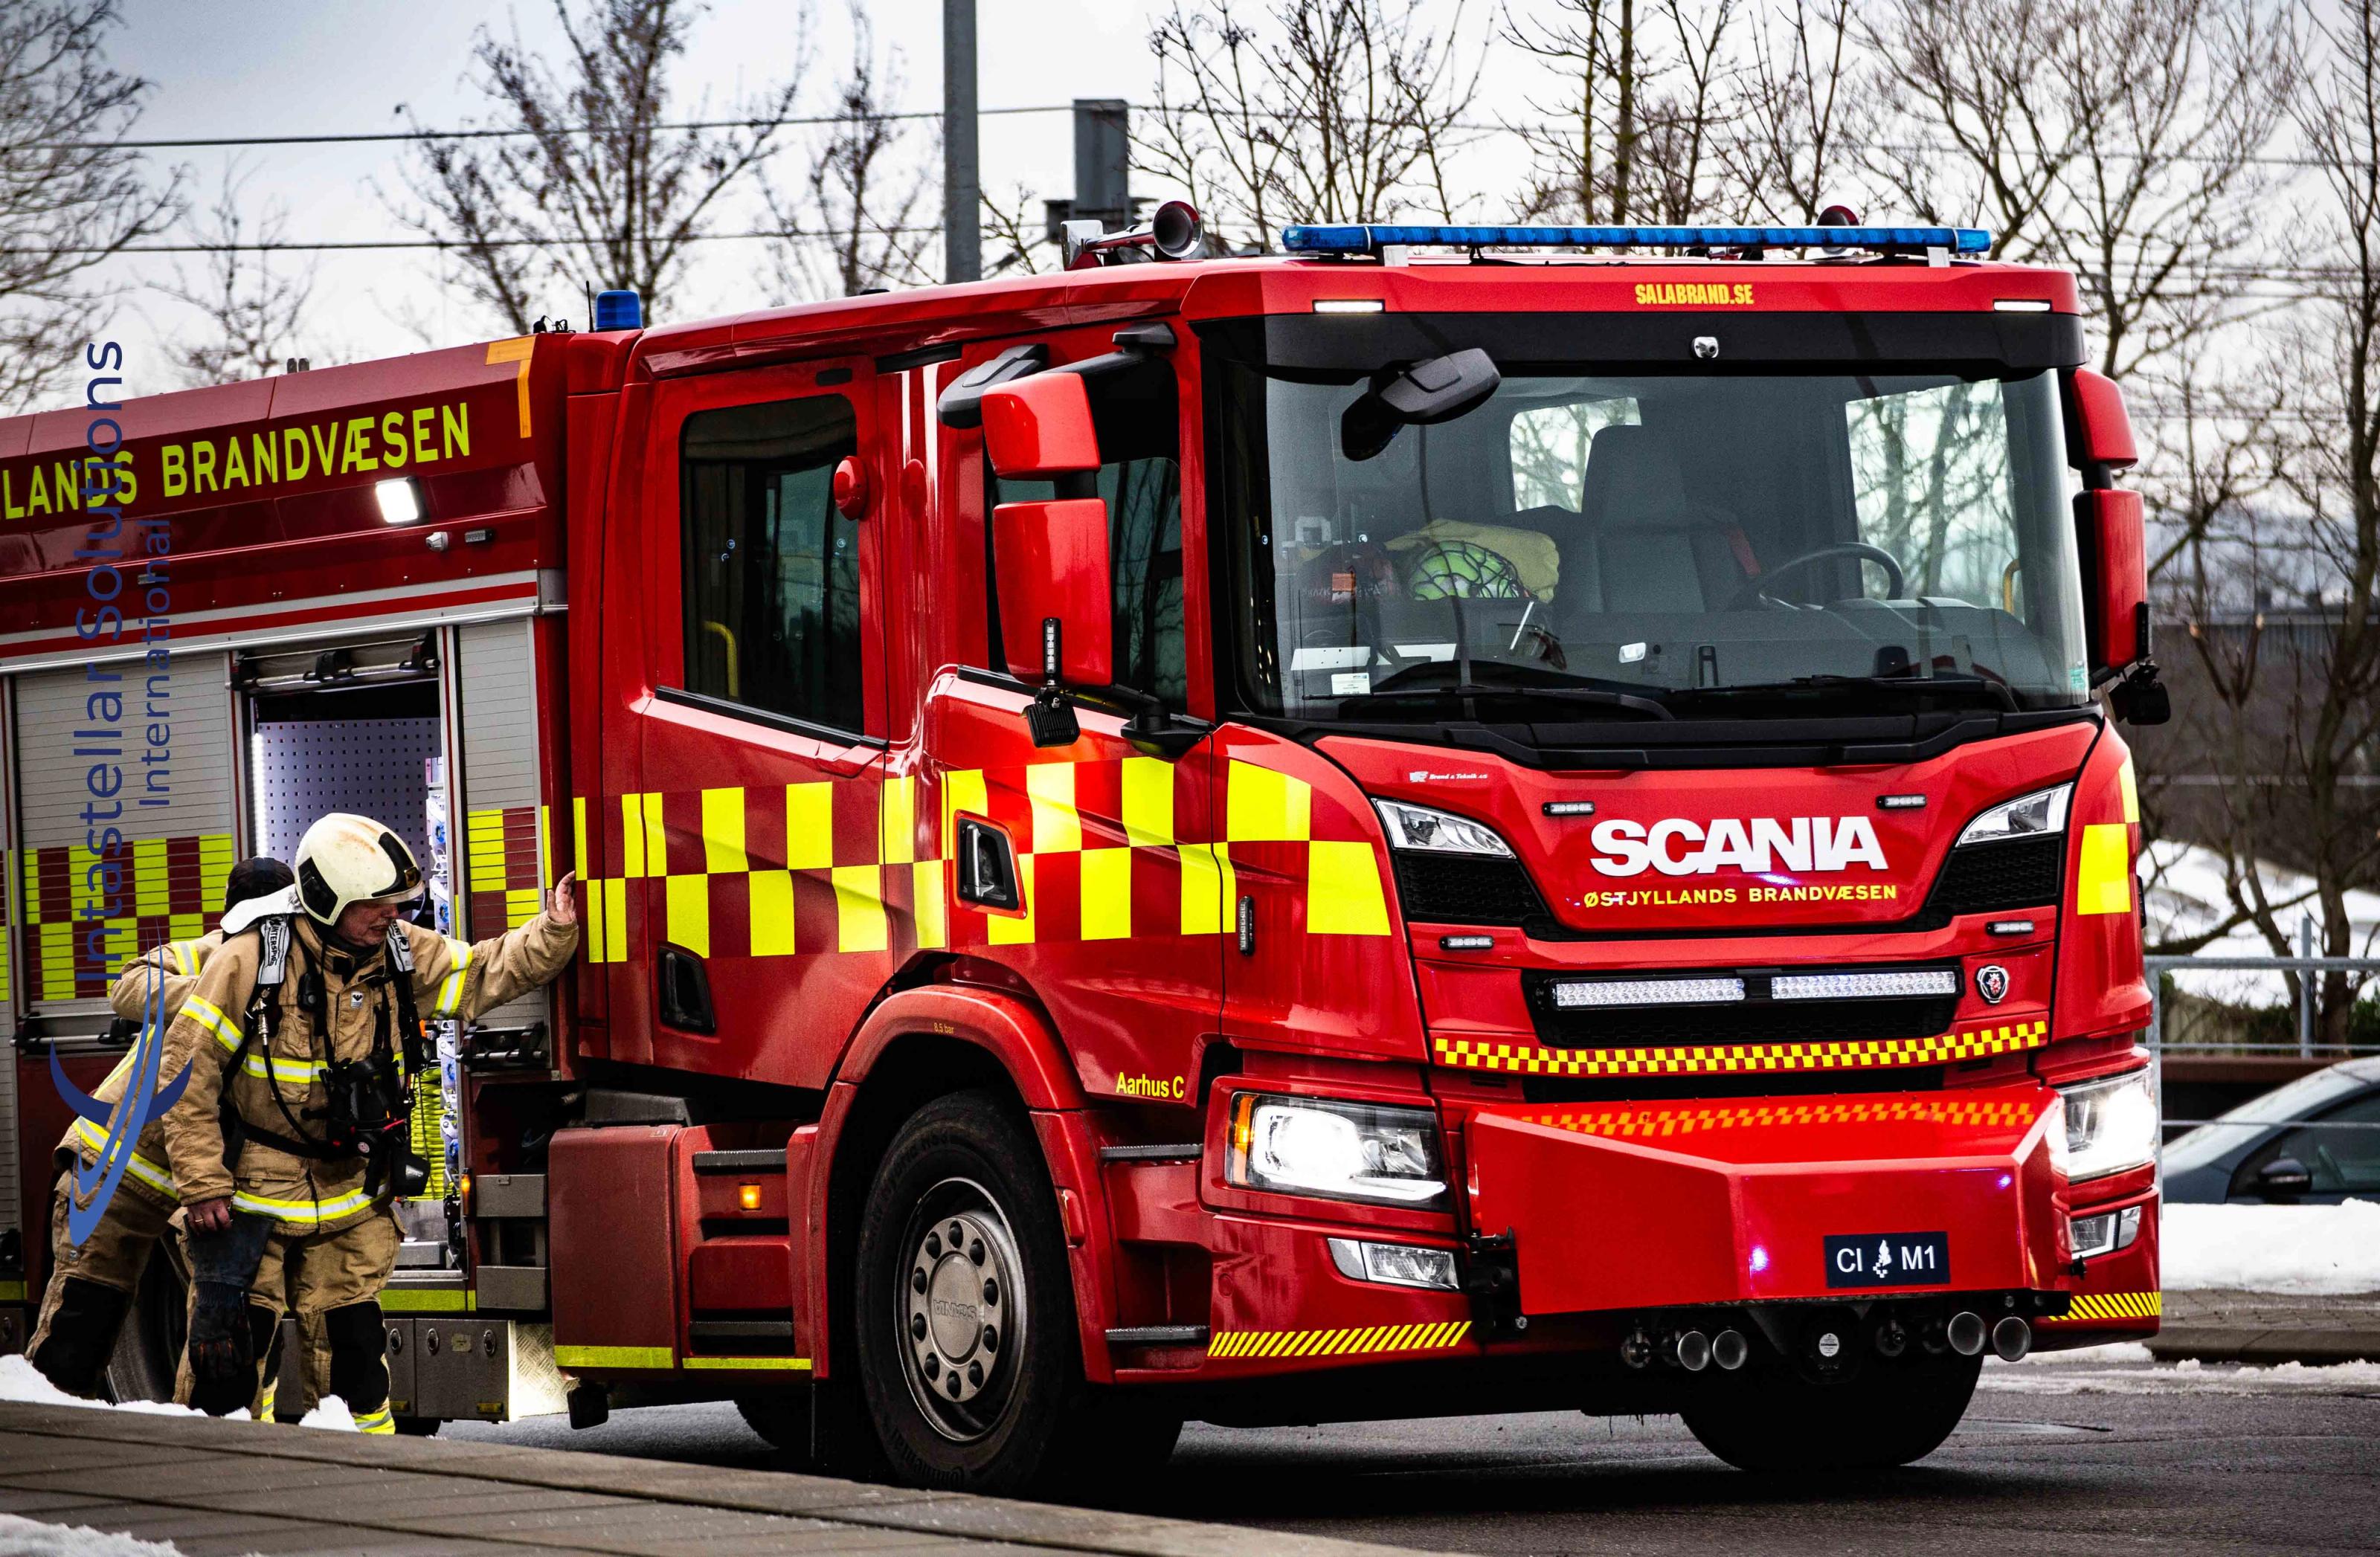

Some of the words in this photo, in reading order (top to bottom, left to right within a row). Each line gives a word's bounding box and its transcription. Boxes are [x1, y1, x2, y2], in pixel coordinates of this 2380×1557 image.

[1635, 283, 1755, 306] SALABRAND.SE
[2, 451, 138, 519] LANDS
[162, 402, 470, 497] BRANDVÆSEN
[1589, 816, 1888, 877] SCANIA
[1583, 888, 1737, 908] ØSTJYLLANDS
[1749, 884, 1897, 903] BRANDVÆSEN
[1116, 1071, 1169, 1097] Aarhus
[1172, 1075, 1185, 1099] C
[1837, 1248, 1862, 1273] CI
[1901, 1245, 1934, 1270] M1
[933, 1299, 977, 1321] SCANIA
